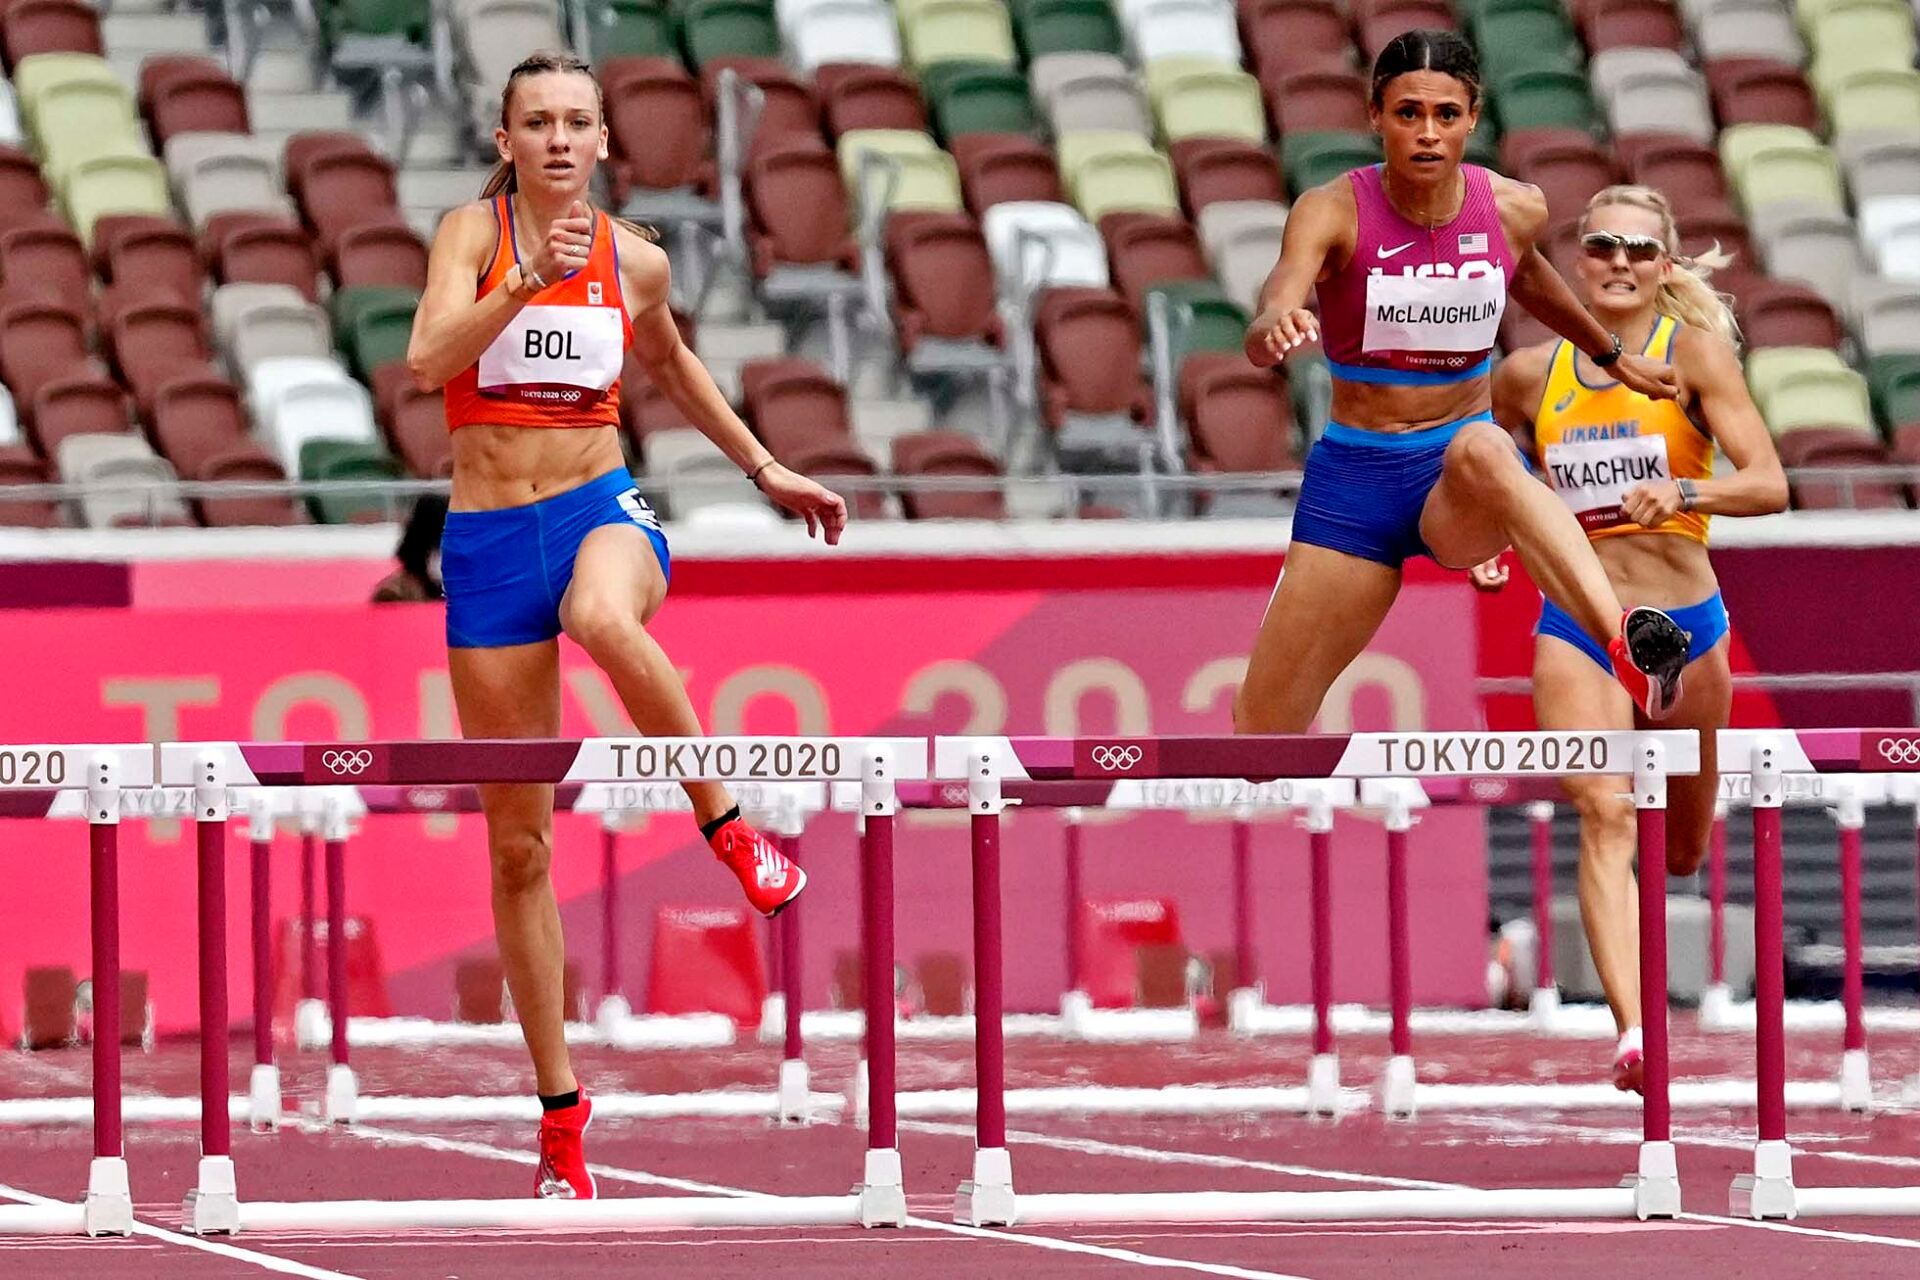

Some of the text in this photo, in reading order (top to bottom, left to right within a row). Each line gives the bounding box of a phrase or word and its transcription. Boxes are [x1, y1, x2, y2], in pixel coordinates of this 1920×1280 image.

[1377, 298, 1498, 324] McLAUGHLIN
[524, 329, 582, 361] BOL
[520, 390, 560, 399] TOKYO 2020
[1563, 420, 1640, 444] UKRAINE
[1551, 455, 1664, 489] TKACHUK
[610, 742, 842, 778] TOKYO 2020
[1378, 736, 1609, 772] TOKYO 2020
